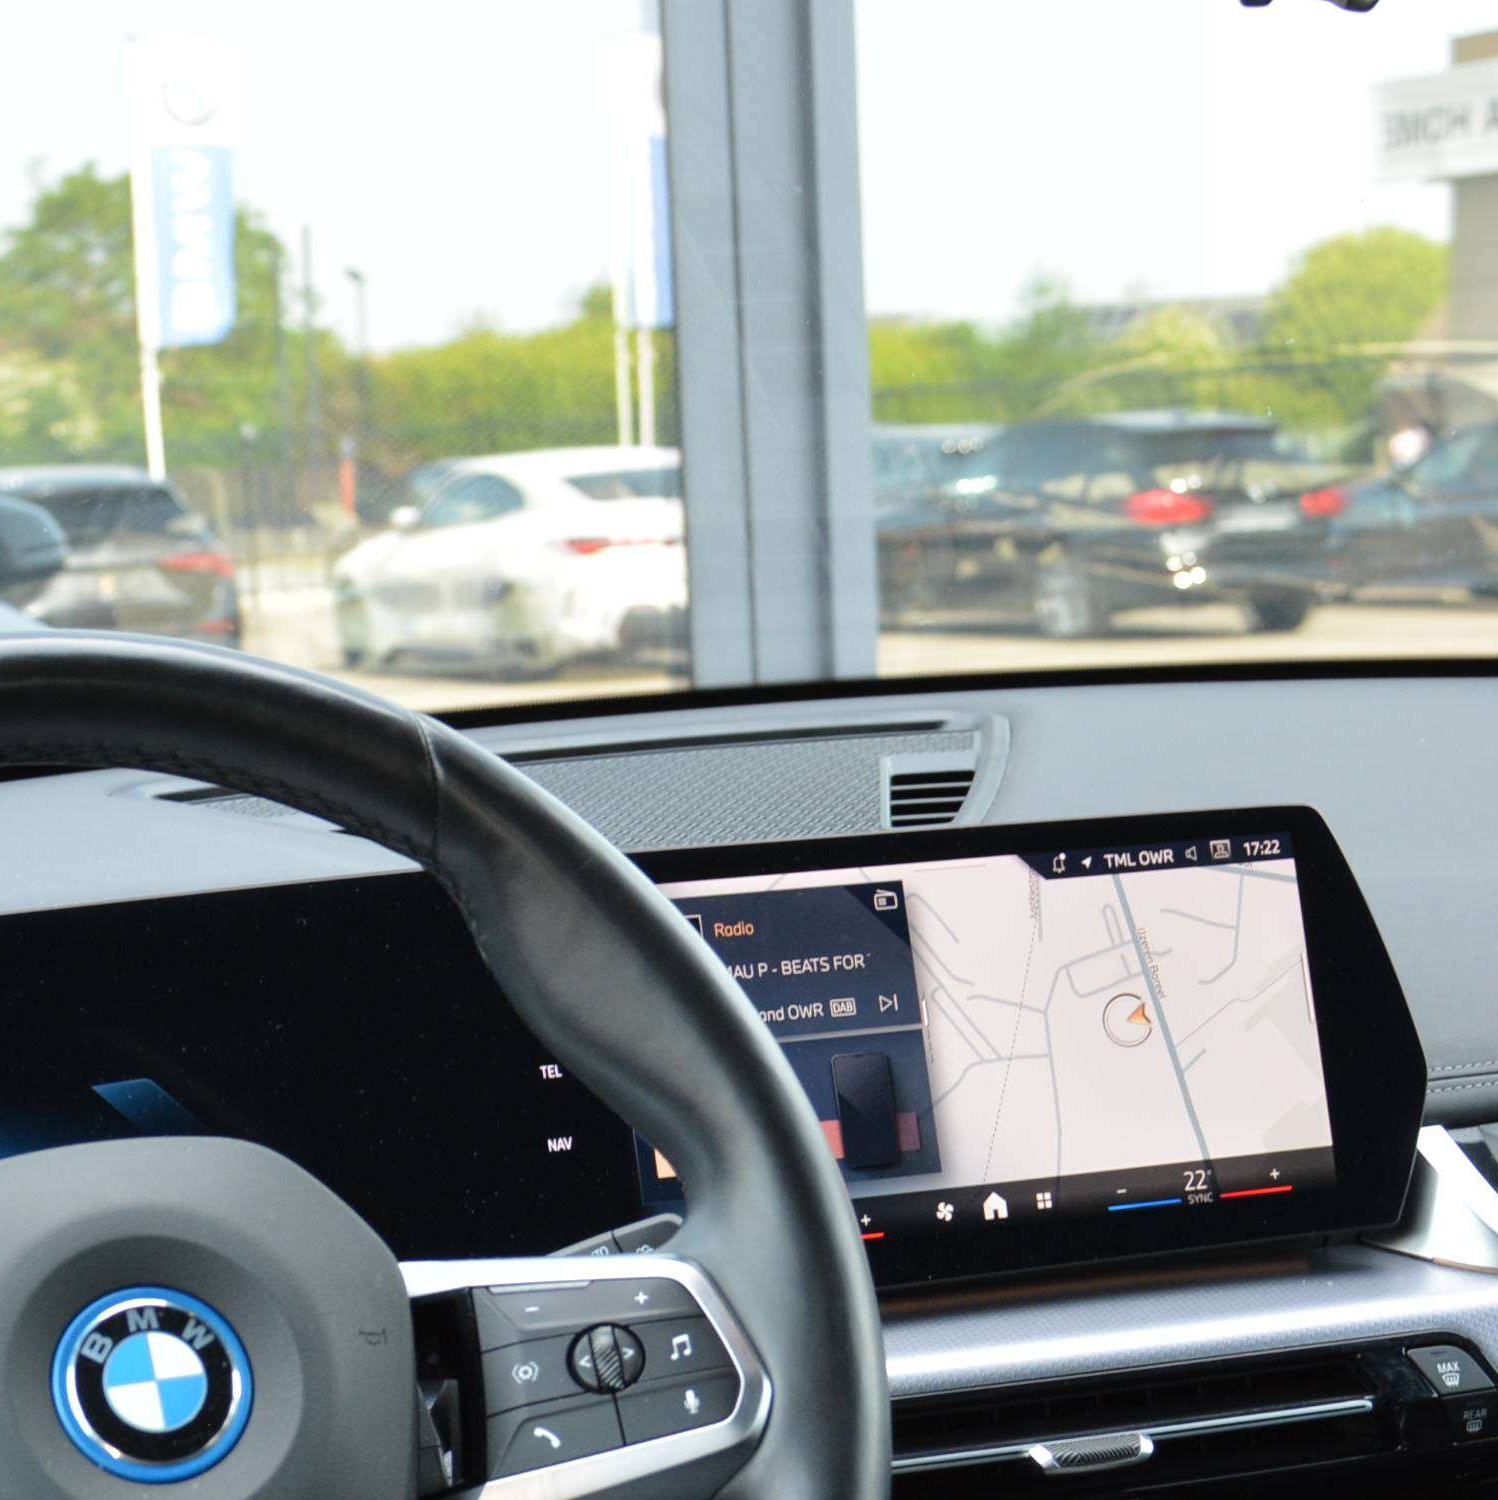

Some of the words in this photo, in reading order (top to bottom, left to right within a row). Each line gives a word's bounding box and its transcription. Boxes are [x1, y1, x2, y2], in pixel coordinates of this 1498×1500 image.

[1243, 839, 1281, 857] 17:22
[1103, 853, 1136, 869] TML
[1138, 849, 1175, 866] OWR
[713, 921, 754, 938] Radio
[757, 962, 769, 977] P
[781, 957, 831, 976] BEATS
[833, 954, 866, 971] FOR
[787, 1003, 824, 1021] OWR
[832, 1001, 854, 1014] DAB
[539, 1064, 563, 1080] TEL
[547, 1136, 573, 1153] NAV
[1187, 1192, 1214, 1205] SYNC
[80, 1307, 215, 1365] BMW
[1436, 1361, 1461, 1374] MAX
[1463, 1408, 1488, 1420] REAR
